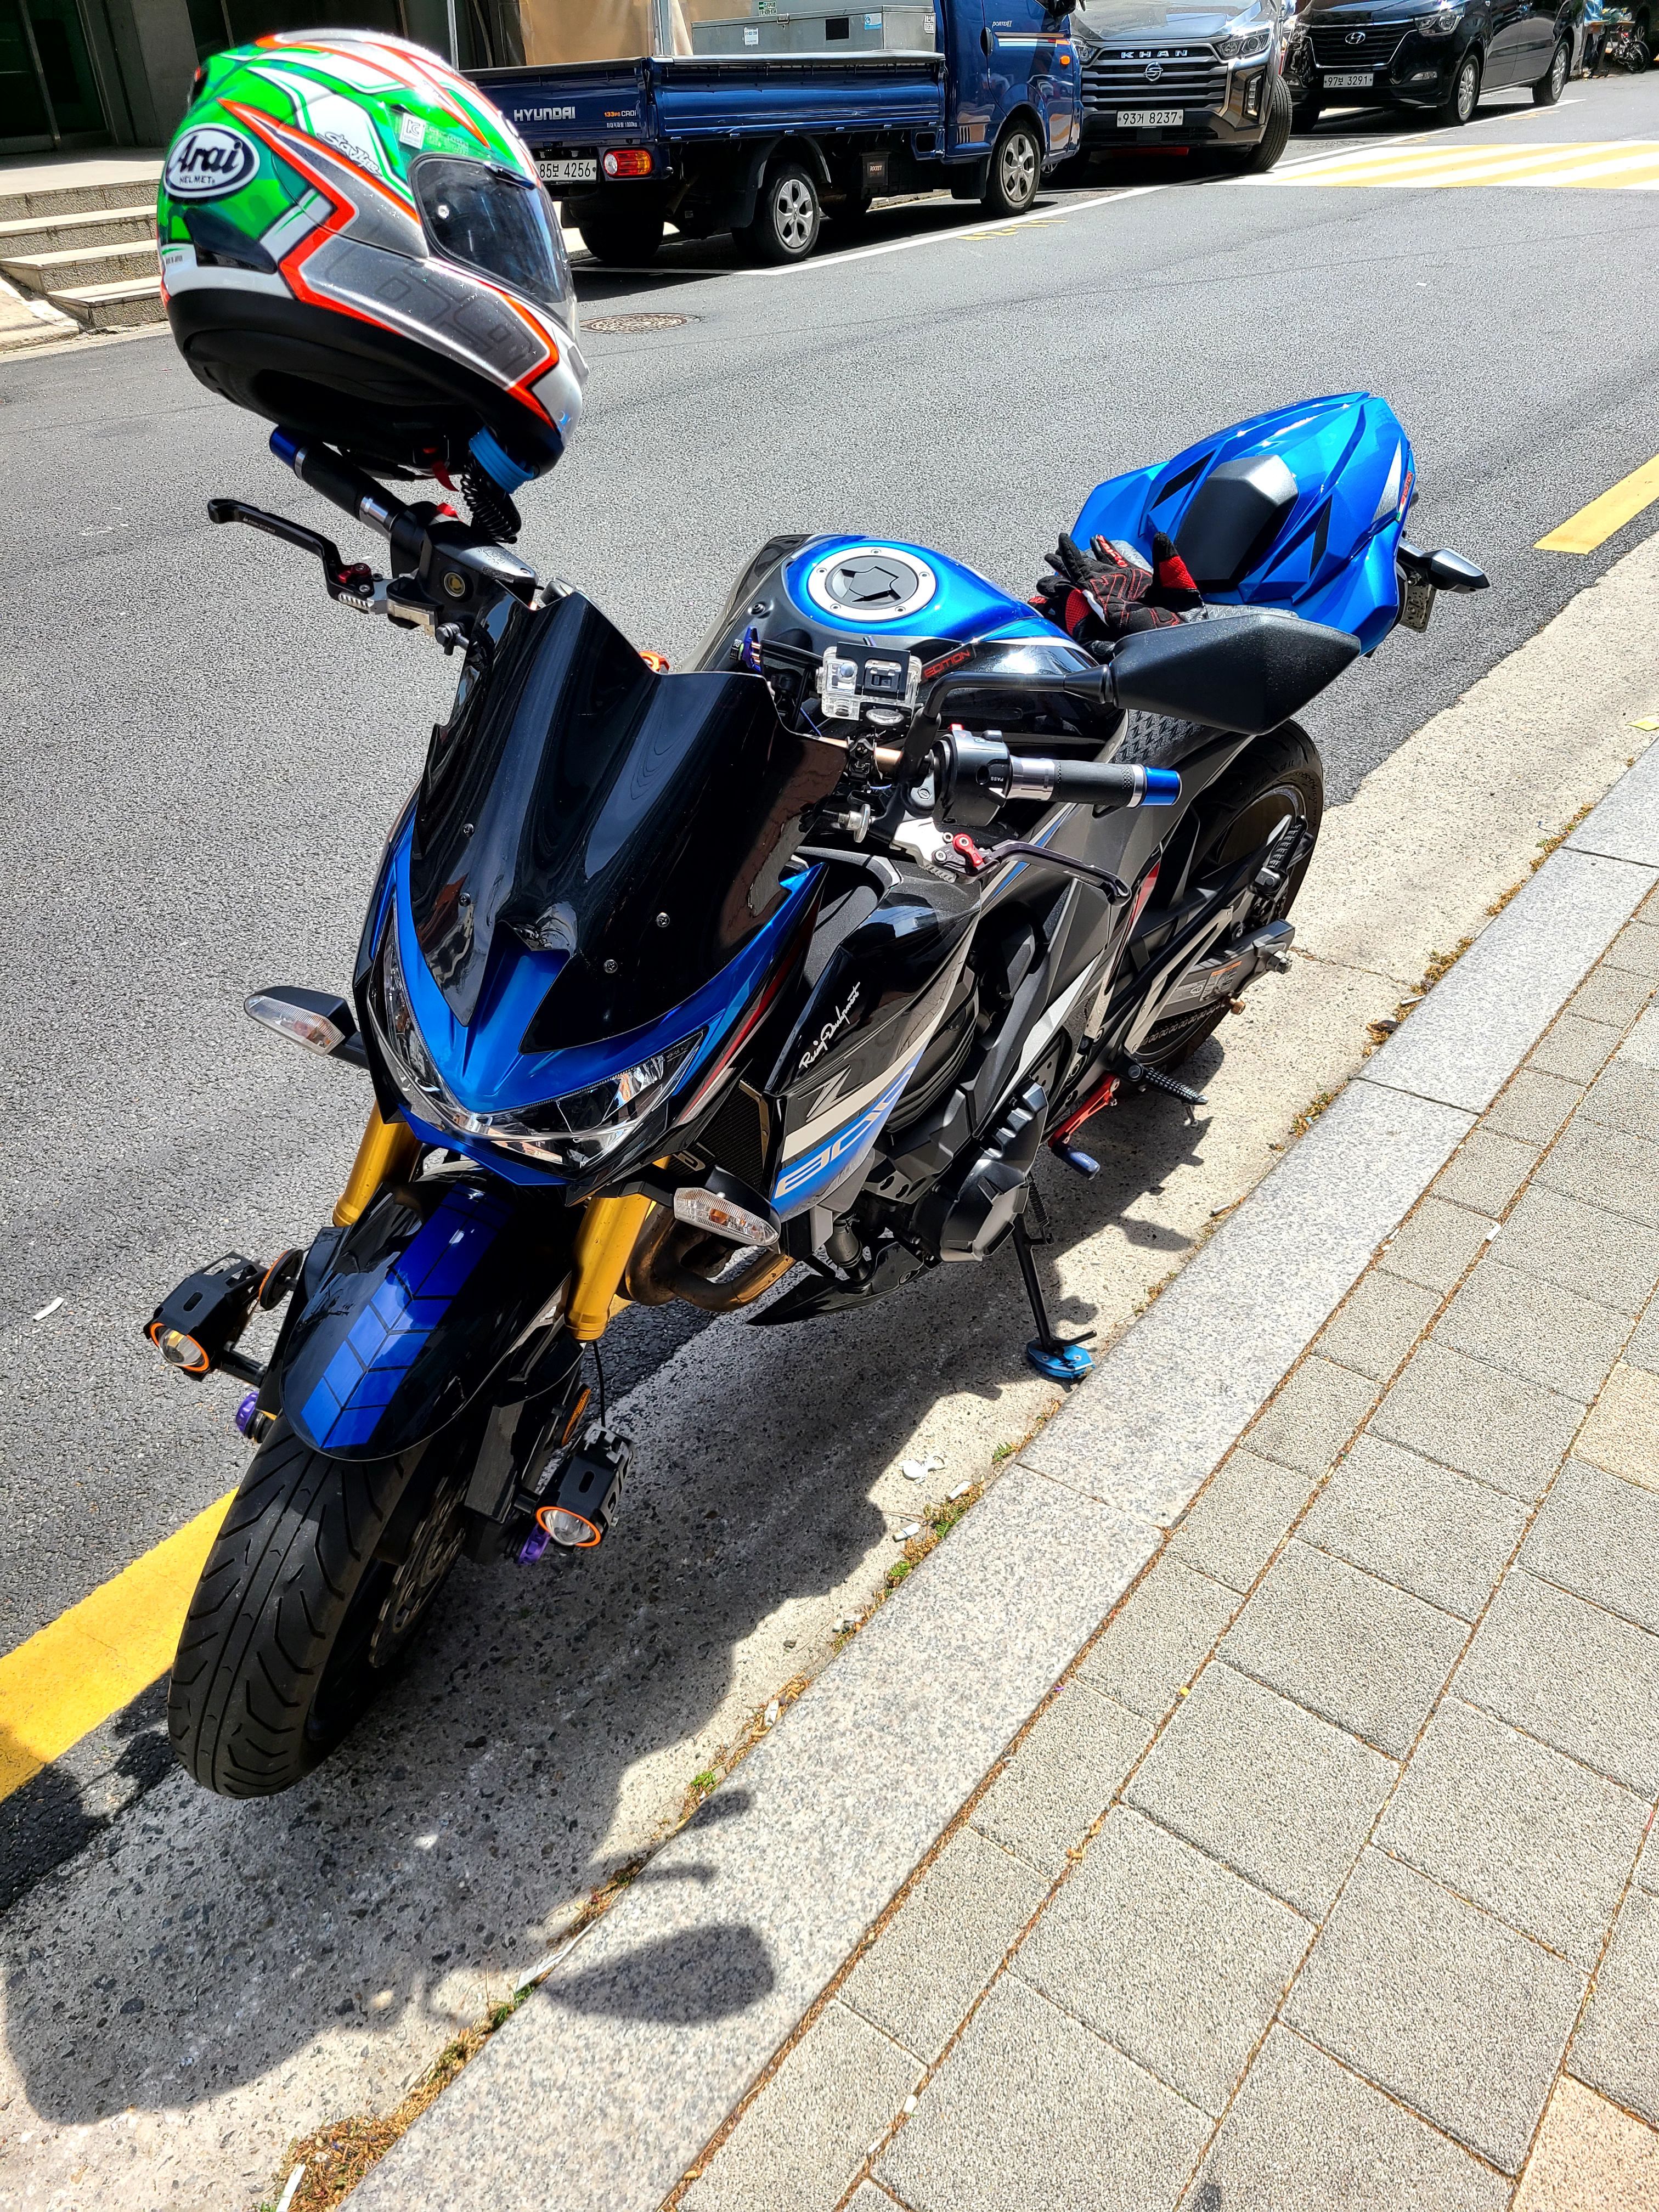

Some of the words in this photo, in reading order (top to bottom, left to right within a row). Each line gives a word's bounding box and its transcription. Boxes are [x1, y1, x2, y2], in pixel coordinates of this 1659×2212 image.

[1121, 49, 1188, 59] KHAN
[1328, 77, 1344, 86] 97보
[1347, 75, 1368, 86] 3291
[514, 106, 576, 122] HYUNDAI
[1123, 113, 1144, 125] 93거
[1149, 111, 1178, 124] 8237
[176, 135, 242, 174] Arai
[540, 163, 560, 178] 85보
[564, 162, 591, 178] 4256
[179, 175, 212, 185] HELMET
[924, 649, 971, 679] EDITION
